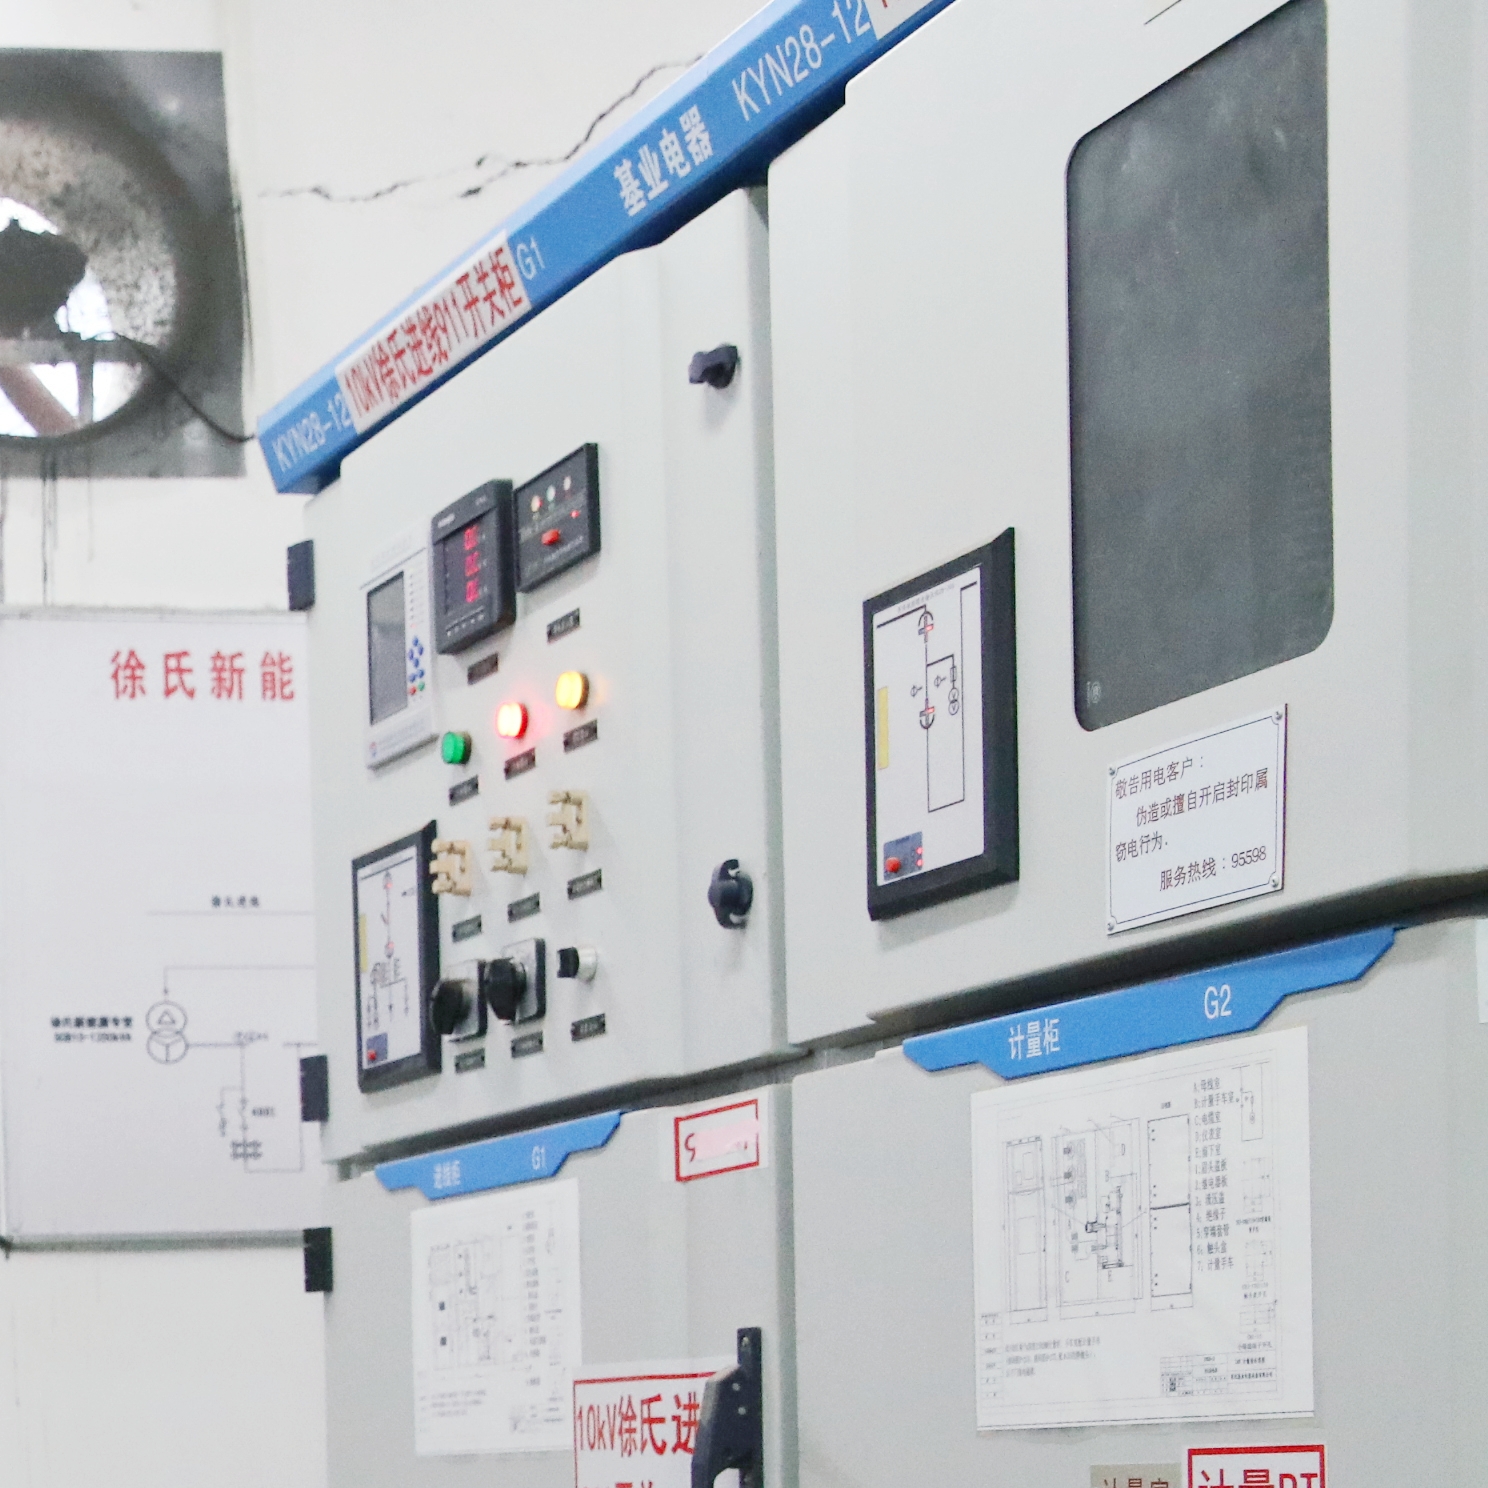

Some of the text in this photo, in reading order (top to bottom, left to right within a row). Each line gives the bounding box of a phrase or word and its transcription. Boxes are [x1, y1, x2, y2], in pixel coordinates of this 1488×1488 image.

[732, 0, 871, 121] KYN28-12
[614, 104, 713, 217] 基业电器
[516, 237, 545, 280] G1
[344, 247, 522, 418] 10kV徐氏进线911开关柜
[272, 391, 351, 473] KYN28-12
[110, 648, 297, 701] 徐氏新能
[1136, 767, 1268, 827] 伪造或擅自开启封印属
[1204, 983, 1233, 1019] G2
[1008, 1017, 1061, 1061] 计量柜
